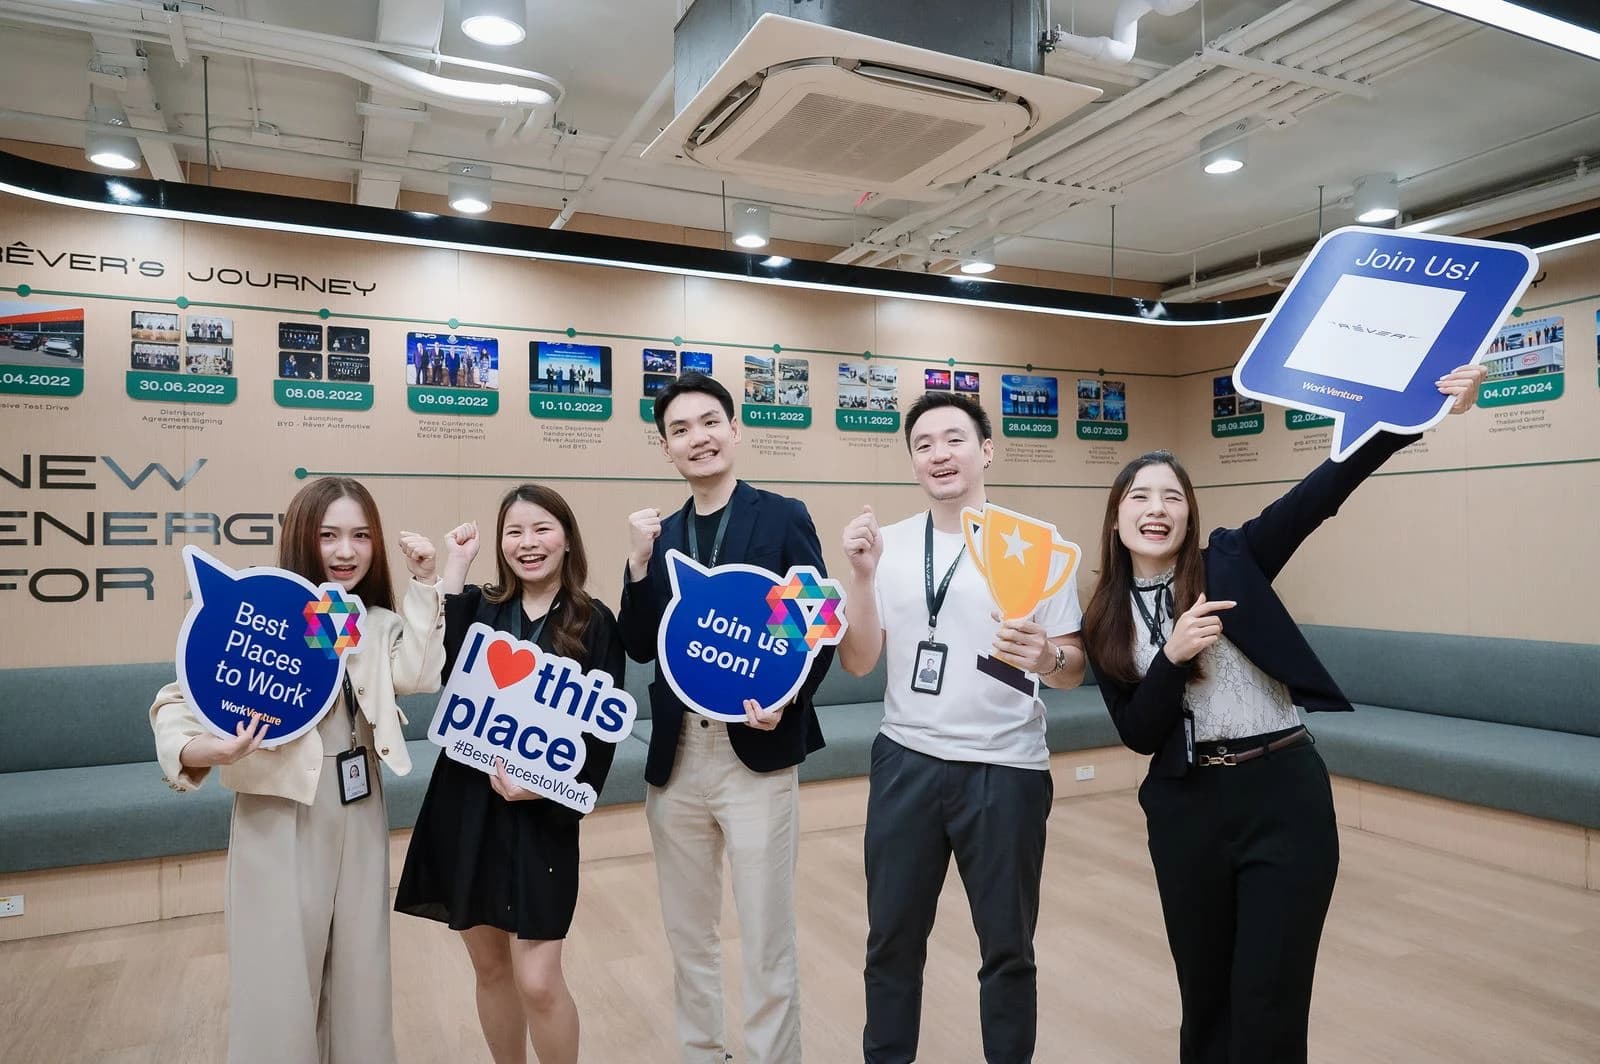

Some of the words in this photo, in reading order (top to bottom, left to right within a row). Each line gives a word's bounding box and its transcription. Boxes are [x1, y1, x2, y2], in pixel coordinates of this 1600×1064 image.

[0, 241, 165, 278] ÊVER'S
[187, 267, 377, 297] JOURNEY
[1355, 248, 1416, 273] Join
[1424, 255, 1480, 281] Us!
[139, 380, 225, 394] 30.06.2022
[285, 388, 363, 401] 08.08.2022
[1302, 381, 1363, 402] WorkVenture
[1483, 381, 1553, 399] 04.07.2024
[418, 394, 489, 407] 09.09.2022
[540, 401, 603, 413] 10.10.2022
[142, 415, 189, 423] Agreement
[192, 417, 223, 425] Signing
[160, 409, 205, 417] Distributor
[303, 415, 344, 423] Launching
[750, 410, 804, 421] 01.11.2022
[843, 415, 893, 425] 11.11.2022
[1520, 408, 1545, 417] Factory
[161, 423, 204, 431] Ceremony
[1008, 423, 1052, 433] 28.04.2023
[1517, 423, 1552, 431] Ceremony
[0, 511, 286, 546] NERG
[235, 601, 289, 640] Best
[697, 608, 752, 643] Join
[757, 631, 789, 656] us
[225, 630, 302, 675] Places
[686, 639, 761, 679] soon!
[215, 660, 241, 687] to
[462, 632, 485, 674] I
[533, 662, 628, 733] this
[437, 693, 577, 772] place
[453, 739, 589, 806] #BestPlacestoWork
